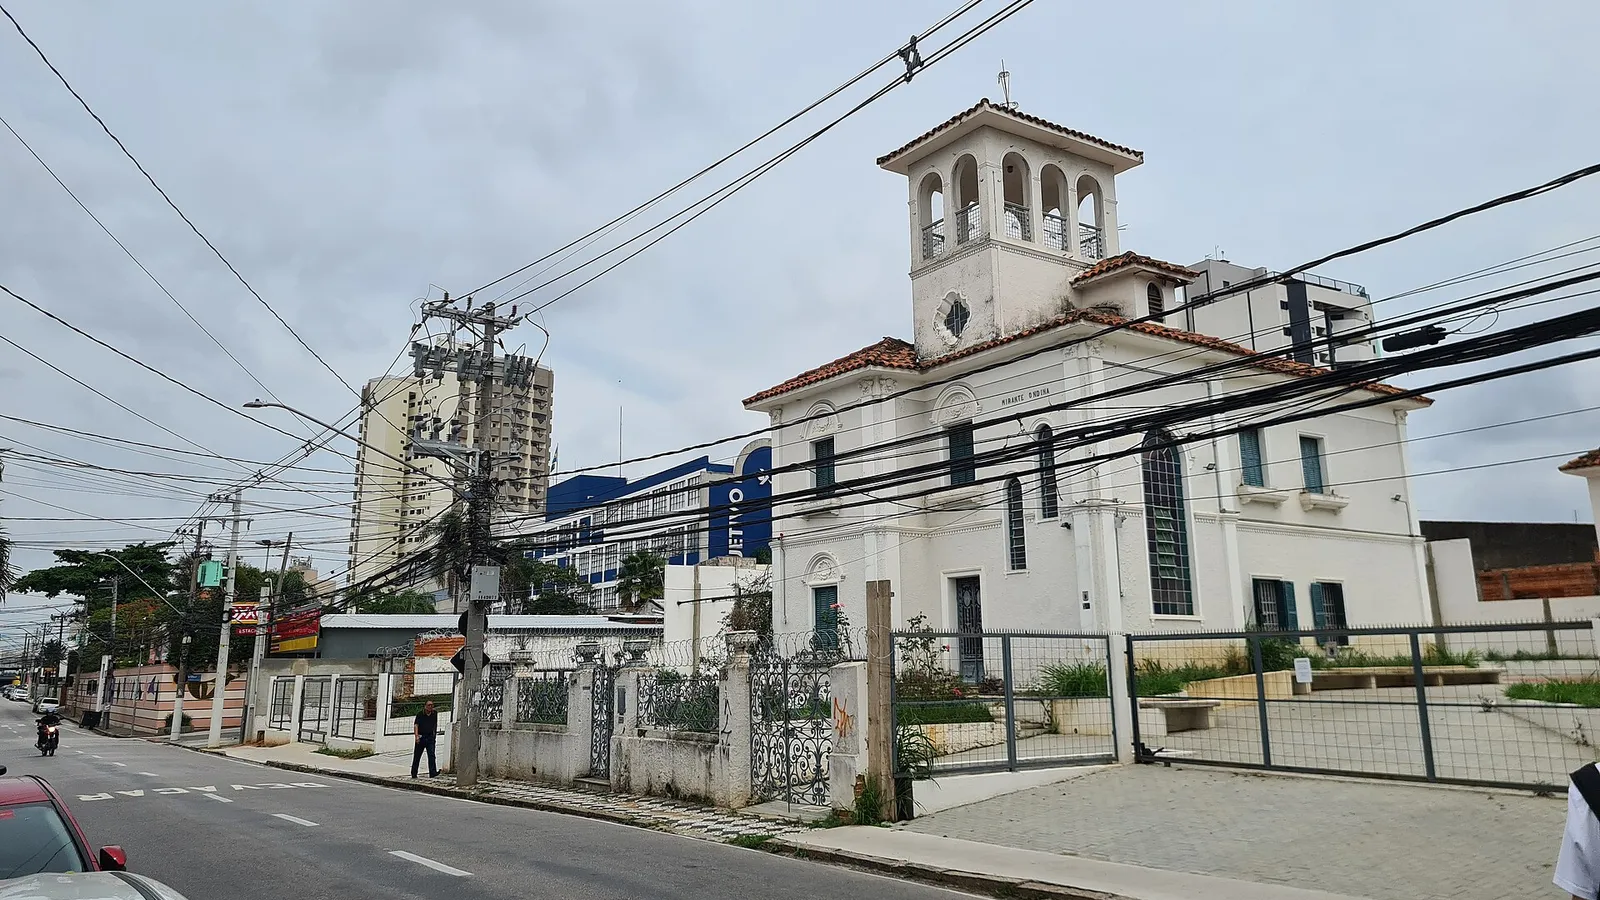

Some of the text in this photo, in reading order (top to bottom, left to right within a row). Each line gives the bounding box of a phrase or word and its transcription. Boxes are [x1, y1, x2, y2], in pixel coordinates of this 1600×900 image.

[1001, 387, 1050, 406] MIRANTE ONDINA
[76, 782, 332, 801] DEVAGAR
